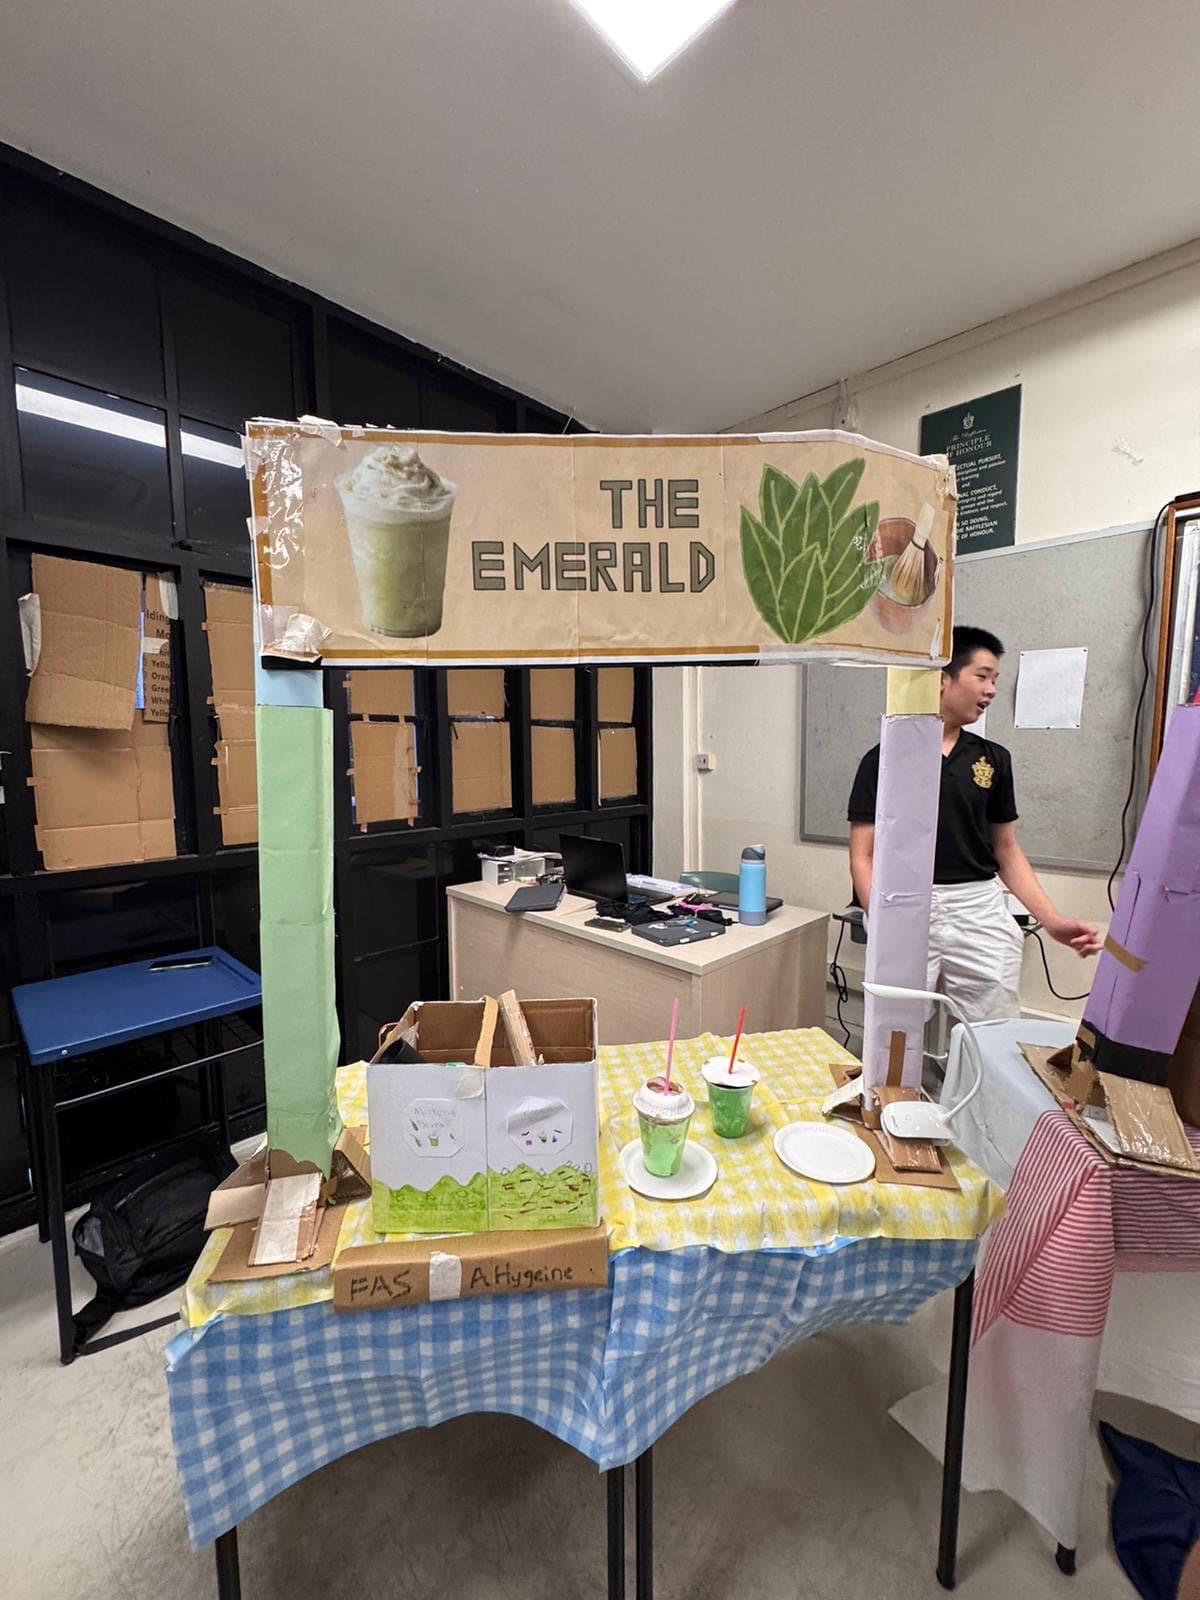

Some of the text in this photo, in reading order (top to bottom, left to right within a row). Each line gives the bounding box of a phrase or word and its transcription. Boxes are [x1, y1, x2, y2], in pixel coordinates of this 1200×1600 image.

[946, 434, 991, 451] PRINCIPLE
[600, 479, 699, 528] THE
[471, 541, 715, 593] EMERALD
[350, 1269, 412, 1301] FAS
